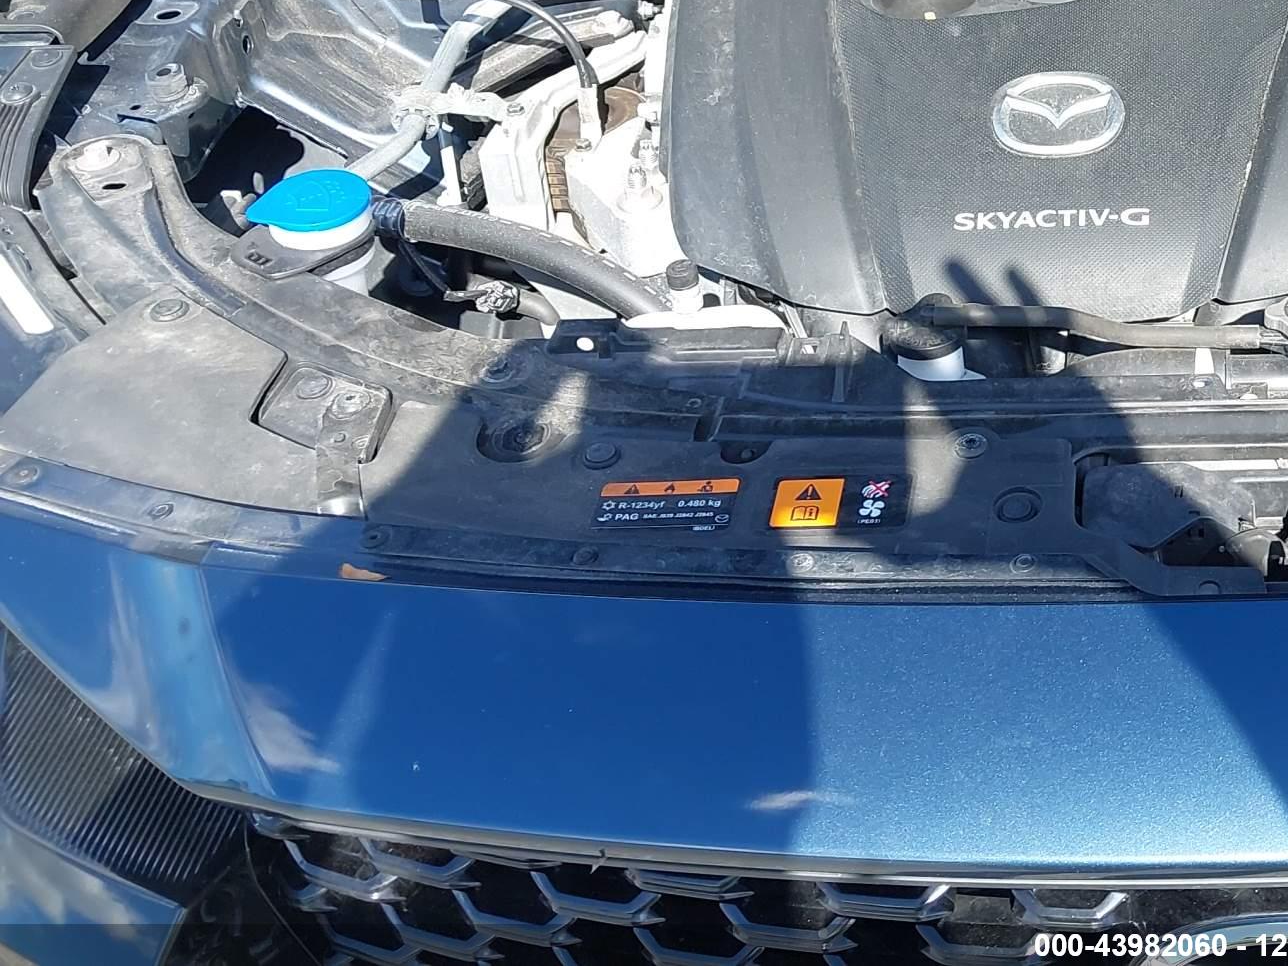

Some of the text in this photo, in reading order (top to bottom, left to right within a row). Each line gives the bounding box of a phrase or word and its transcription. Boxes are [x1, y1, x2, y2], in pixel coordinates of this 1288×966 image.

[953, 208, 1150, 231] SKYACTIV-G
[618, 499, 722, 510] R-1234yf 0.480 kg
[615, 513, 639, 521] PAG
